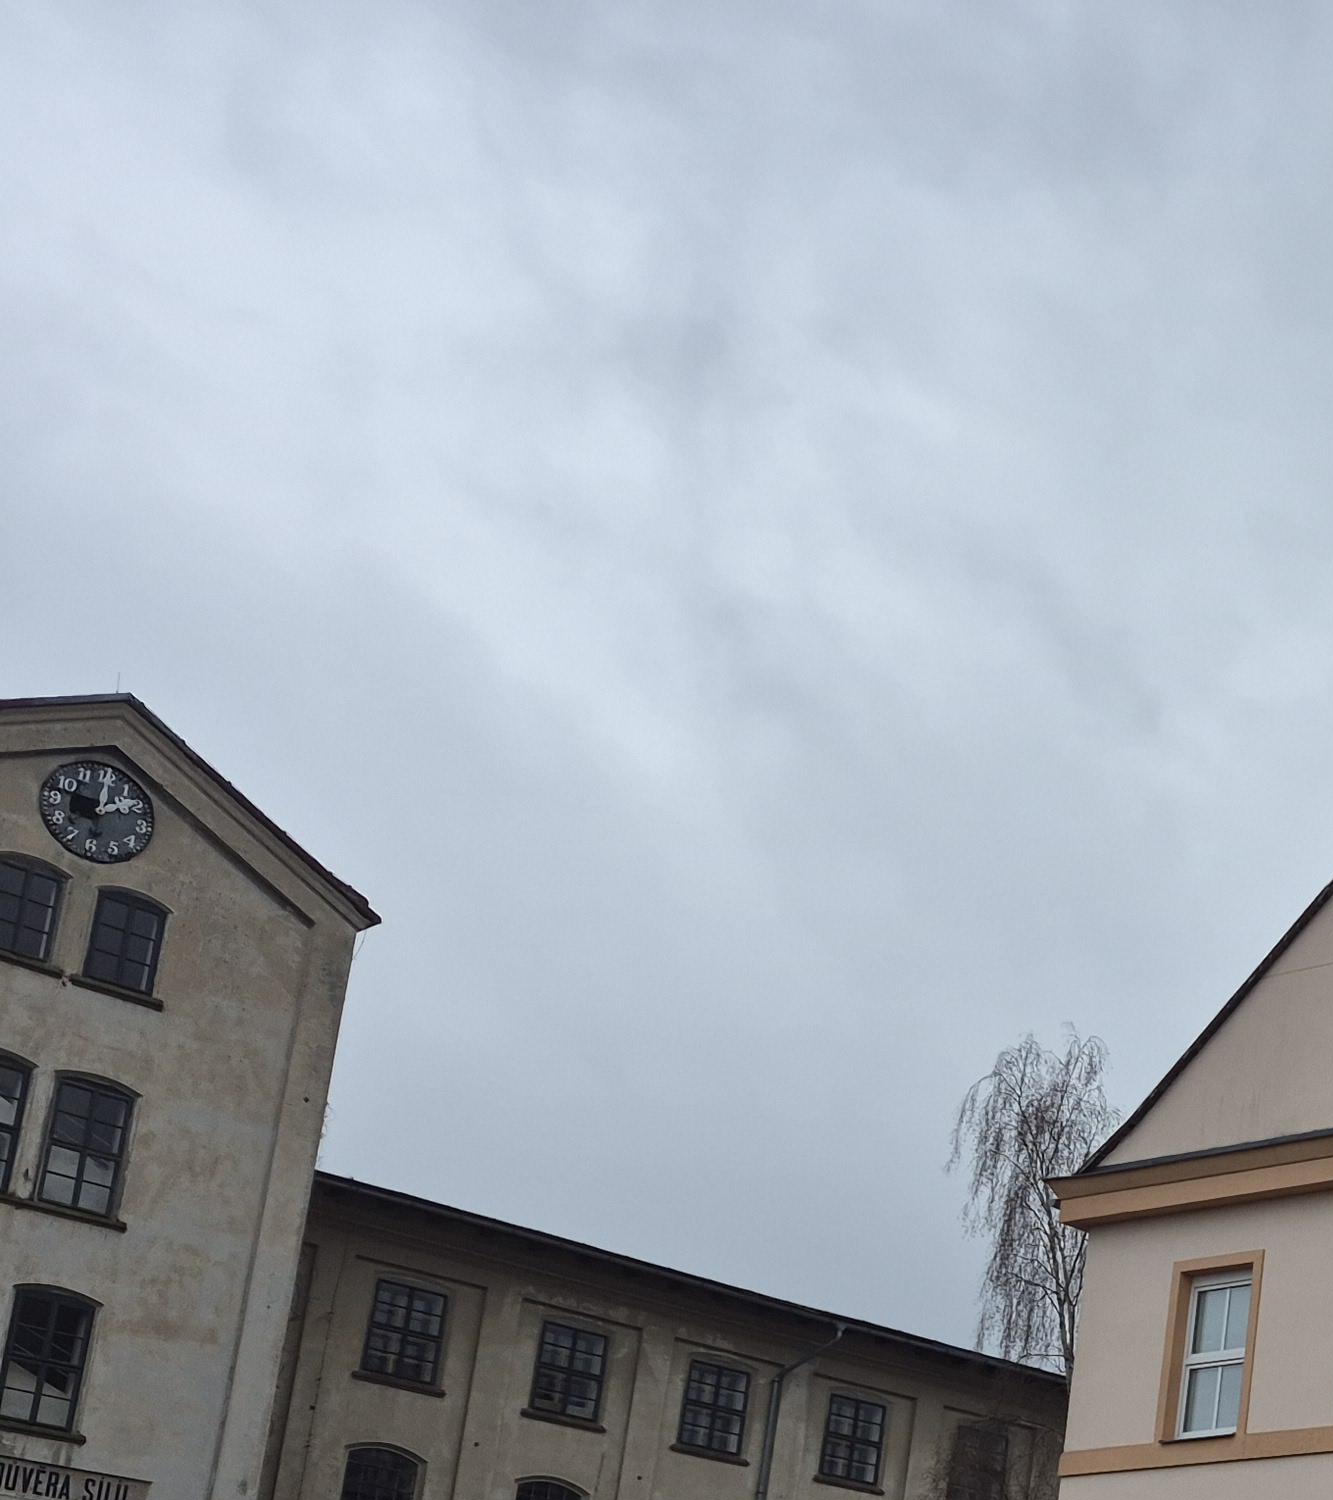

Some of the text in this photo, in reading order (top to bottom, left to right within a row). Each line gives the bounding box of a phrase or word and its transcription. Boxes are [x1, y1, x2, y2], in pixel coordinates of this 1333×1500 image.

[78, 768, 91, 783] 11
[59, 776, 77, 792] 10
[123, 784, 129, 796] 1
[50, 791, 61, 804] 9
[131, 800, 143, 813] 2
[53, 811, 65, 824] 8
[136, 820, 147, 833] 3
[63, 827, 79, 841] 7
[85, 839, 97, 852] 6
[108, 841, 119, 855] 5
[123, 835, 136, 848] 4
